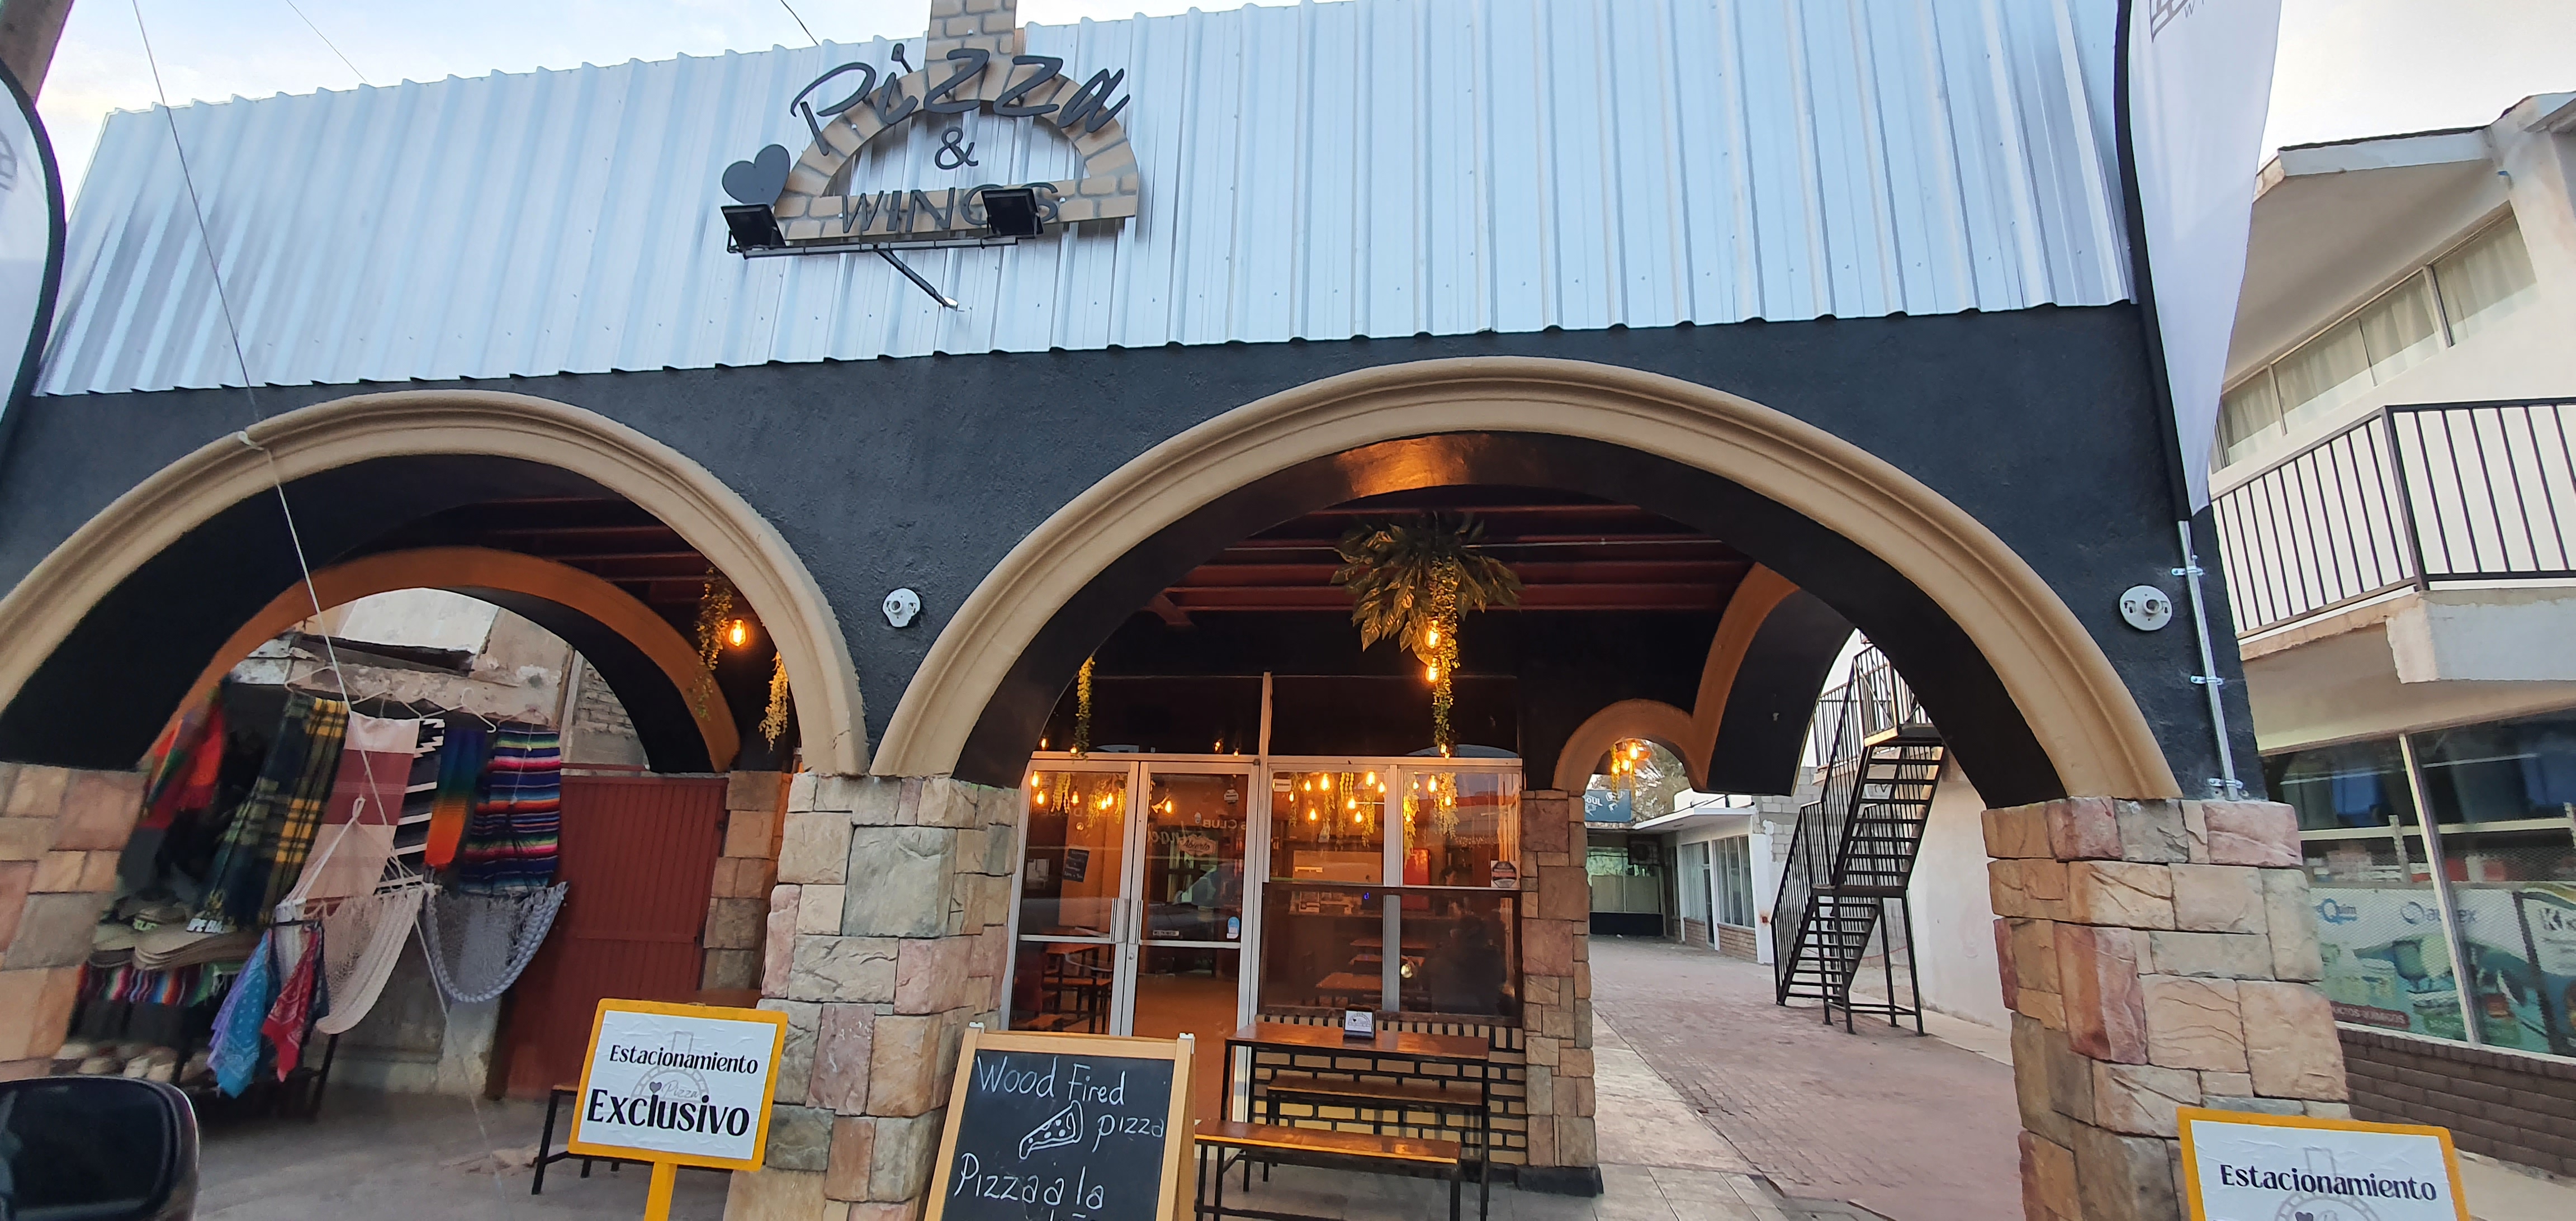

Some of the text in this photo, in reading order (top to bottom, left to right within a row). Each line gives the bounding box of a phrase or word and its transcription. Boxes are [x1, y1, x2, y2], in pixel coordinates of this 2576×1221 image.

[790, 43, 1130, 157] Pizza
[934, 126, 979, 169] &
[609, 1044, 759, 1075] Estacionamiento
[977, 1055, 1125, 1105] Wood Fired
[586, 1088, 750, 1137] Exclusivo
[1076, 1166, 1105, 1210] la
[2220, 1163, 2437, 1201] Estacionamiento
